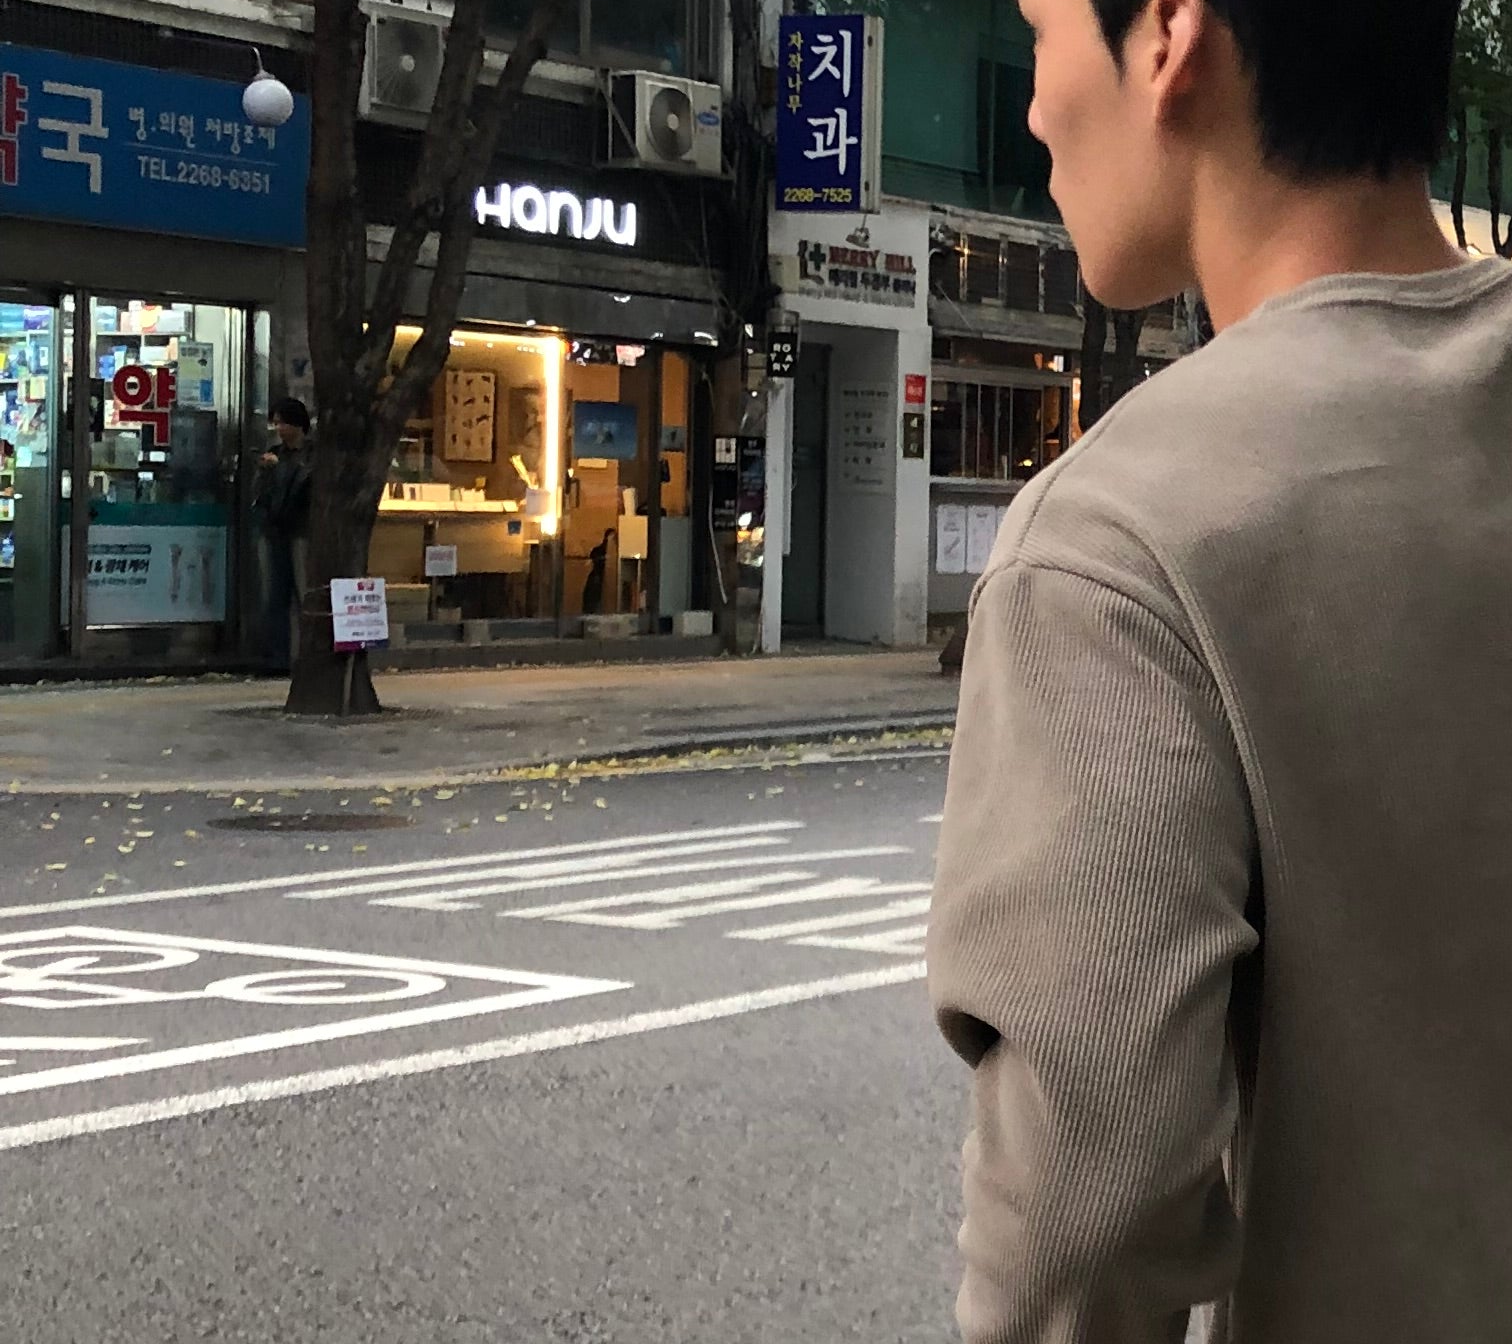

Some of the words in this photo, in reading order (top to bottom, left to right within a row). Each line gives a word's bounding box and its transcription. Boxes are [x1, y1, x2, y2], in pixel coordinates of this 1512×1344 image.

[788, 30, 804, 115] 자작나무
[803, 29, 859, 176] 치과
[112, 365, 177, 447] 약
